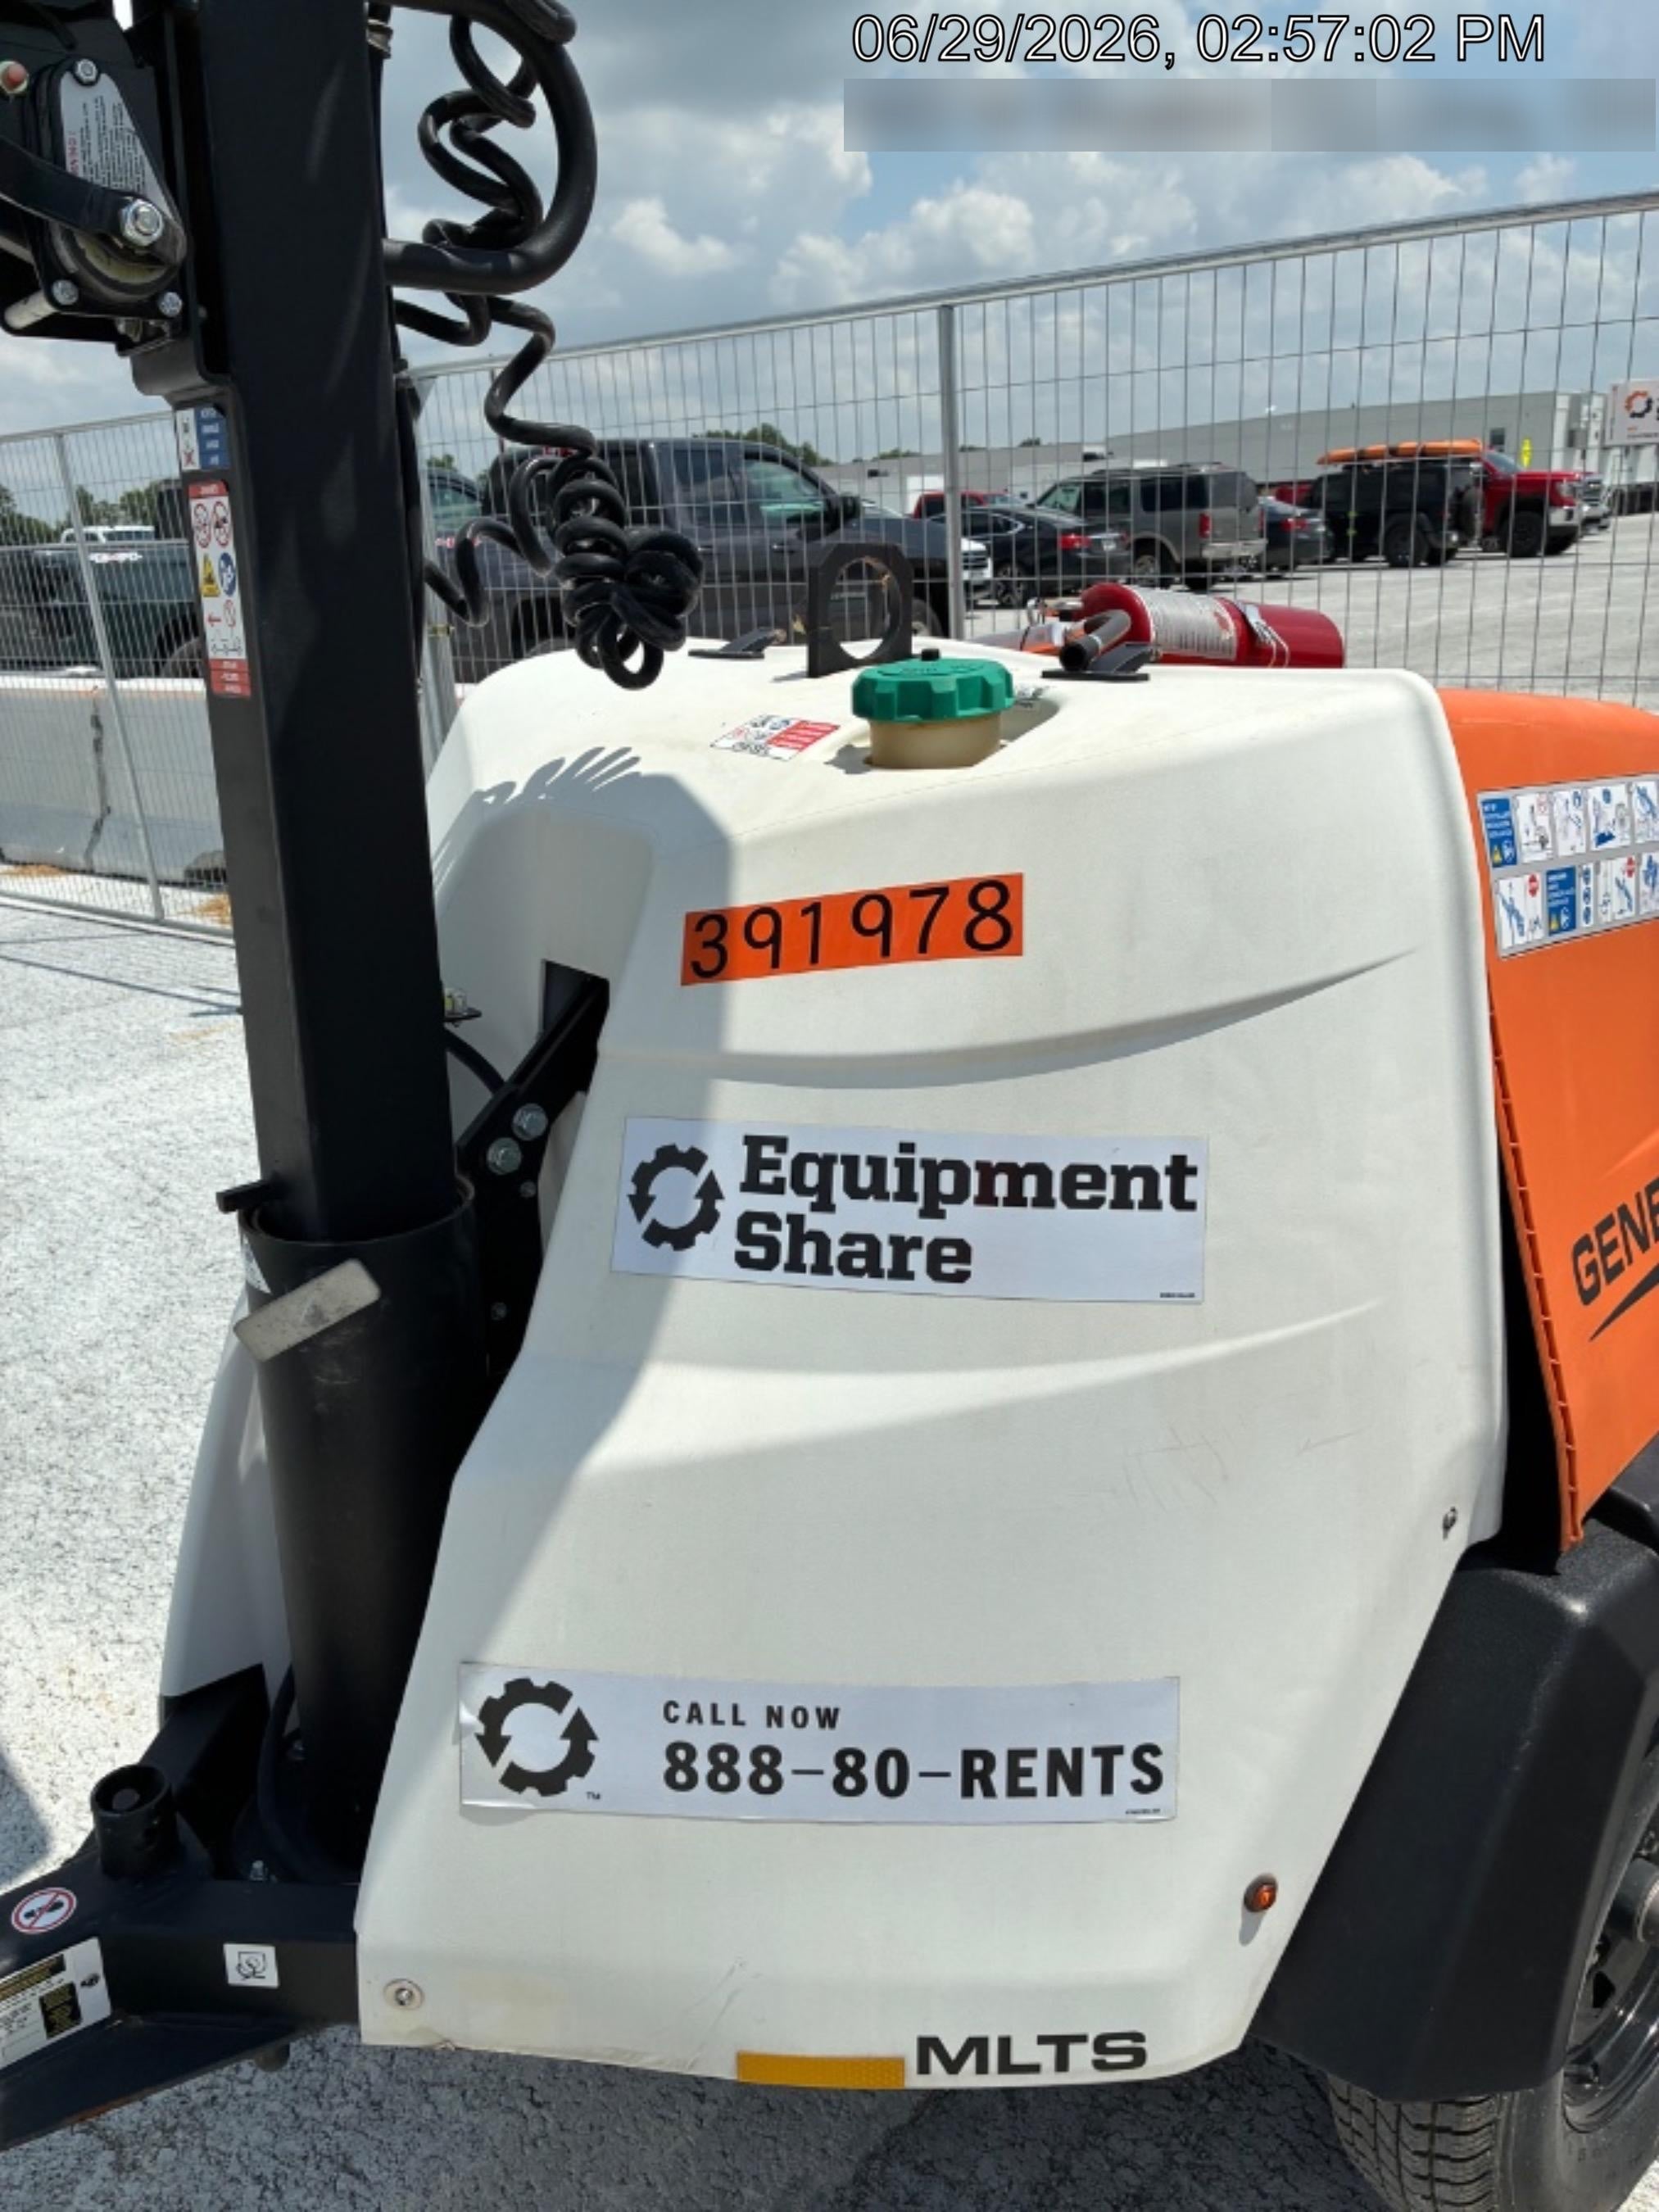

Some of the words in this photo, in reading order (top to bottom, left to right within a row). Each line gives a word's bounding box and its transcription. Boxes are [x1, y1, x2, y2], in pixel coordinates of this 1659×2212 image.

[691, 879, 1013, 978] 391978
[740, 1135, 1198, 1219] Equipment
[734, 1211, 972, 1283] Share
[663, 1701, 747, 1725] CALL
[766, 1706, 841, 1730] NOW
[917, 2030, 1148, 2074] MLTS
